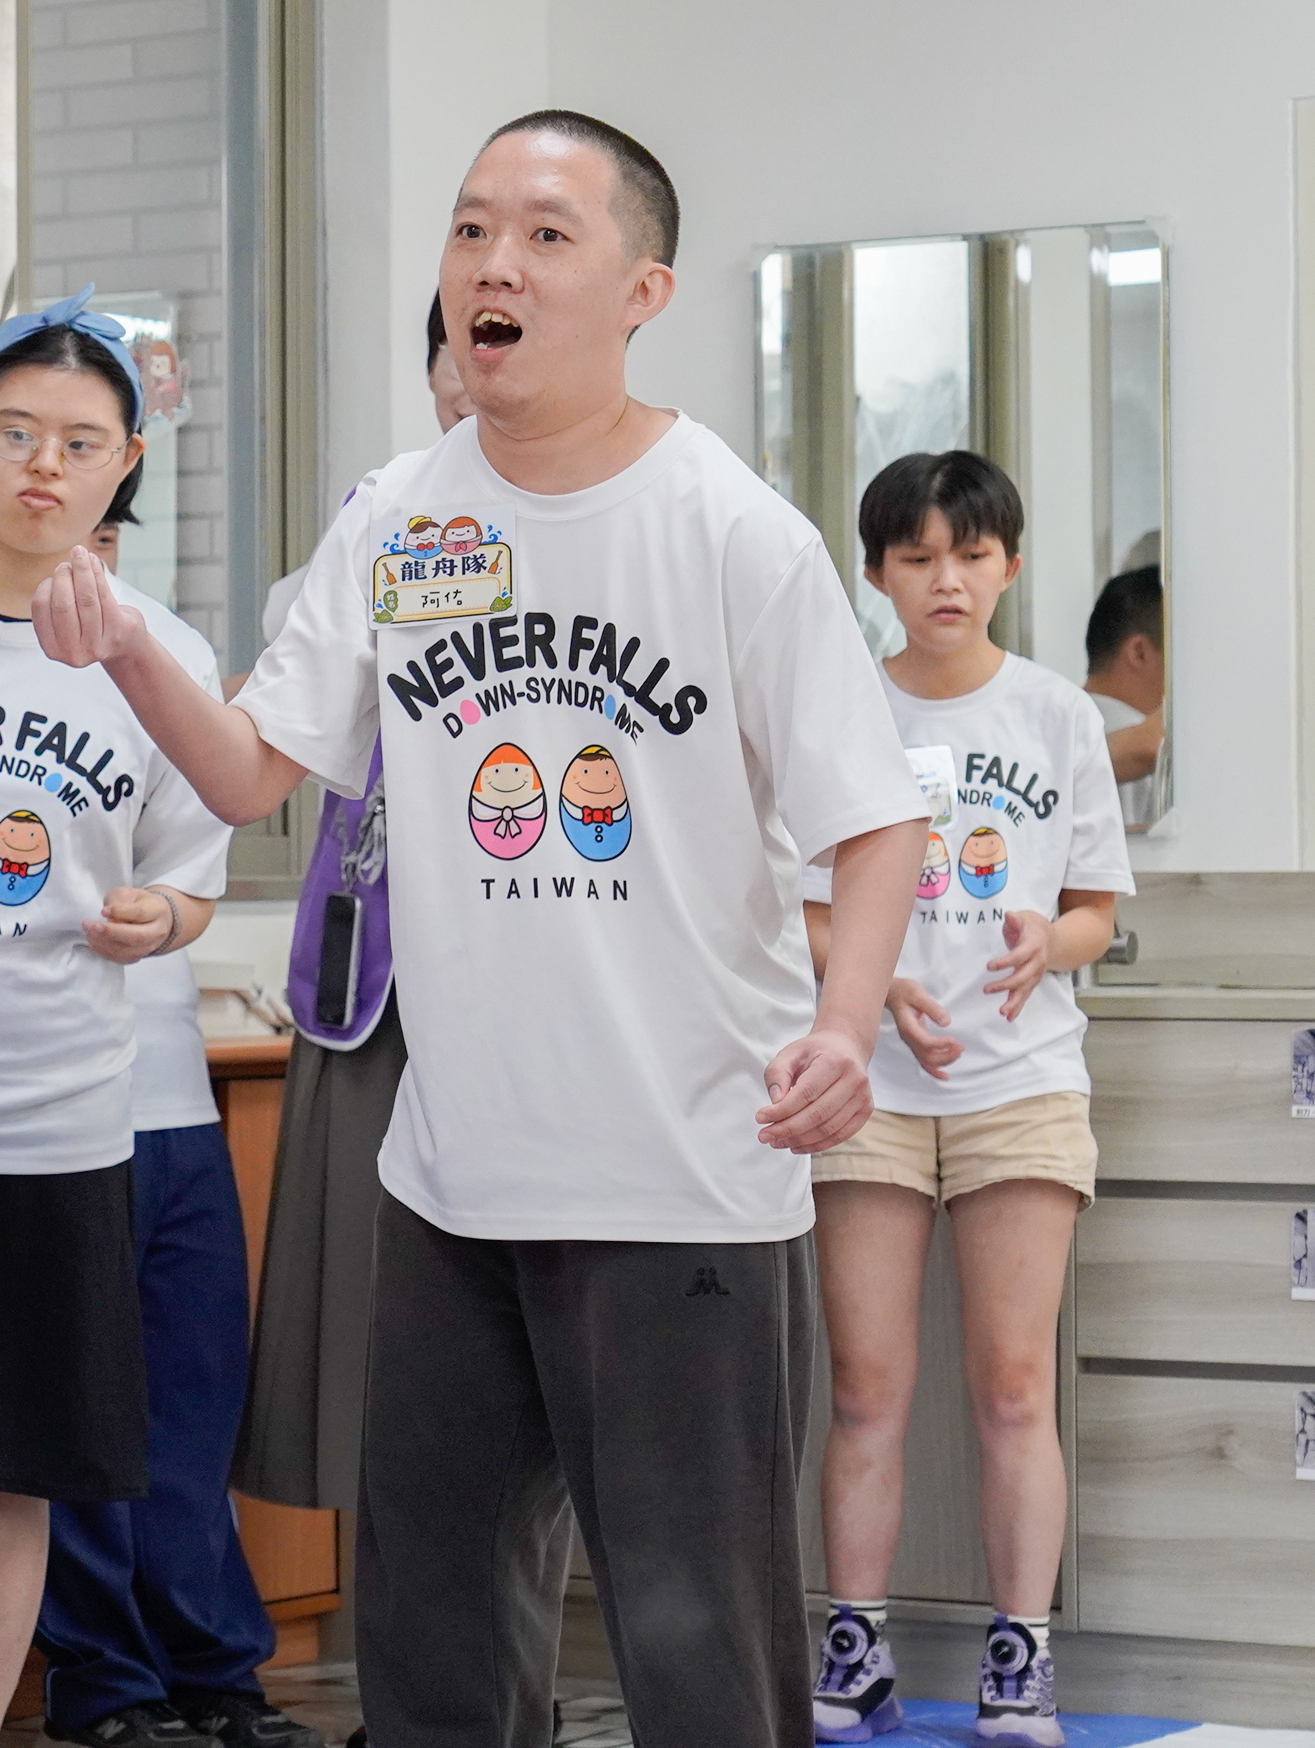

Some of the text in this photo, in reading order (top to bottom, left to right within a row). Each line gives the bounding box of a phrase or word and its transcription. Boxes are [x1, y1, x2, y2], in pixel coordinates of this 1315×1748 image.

[399, 553, 488, 582] 龍舟隊
[387, 612, 708, 736] NEVER FALLS
[14, 710, 135, 812] FALLS
[965, 753, 1060, 820] FALLS
[957, 787, 1026, 828] NDROME
[481, 876, 628, 901] TAIWAN
[919, 907, 1004, 925] TAIWAN
